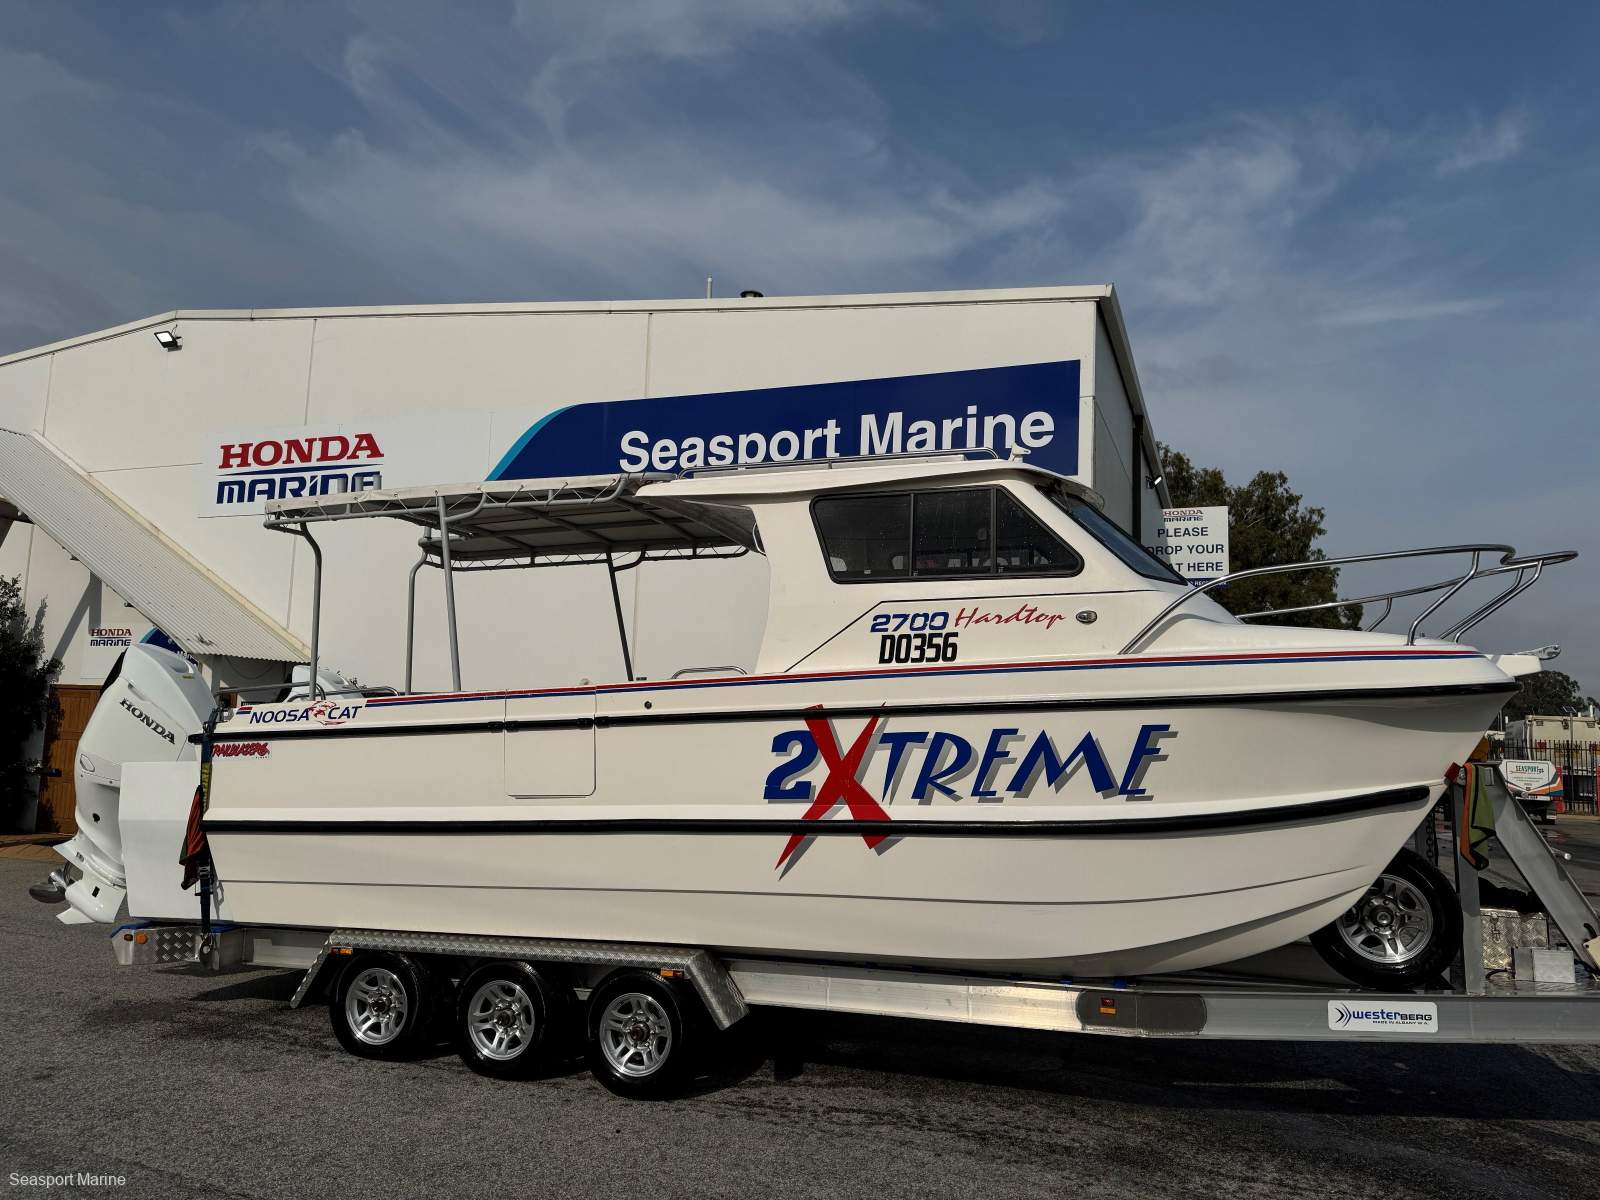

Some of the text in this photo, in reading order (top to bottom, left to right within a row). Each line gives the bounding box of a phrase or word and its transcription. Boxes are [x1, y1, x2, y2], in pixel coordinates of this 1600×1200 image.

[619, 405, 1055, 473] Seasport Marine
[218, 433, 385, 469] HONDA
[1157, 527, 1209, 538] PLEASE
[1187, 544, 1225, 555] YOUR
[1187, 562, 1224, 572] HERE
[870, 603, 1067, 633] 2700 Hardtop
[91, 628, 132, 637] HONDA
[119, 698, 175, 745] HONDA
[250, 706, 362, 725] NOOSA CAT
